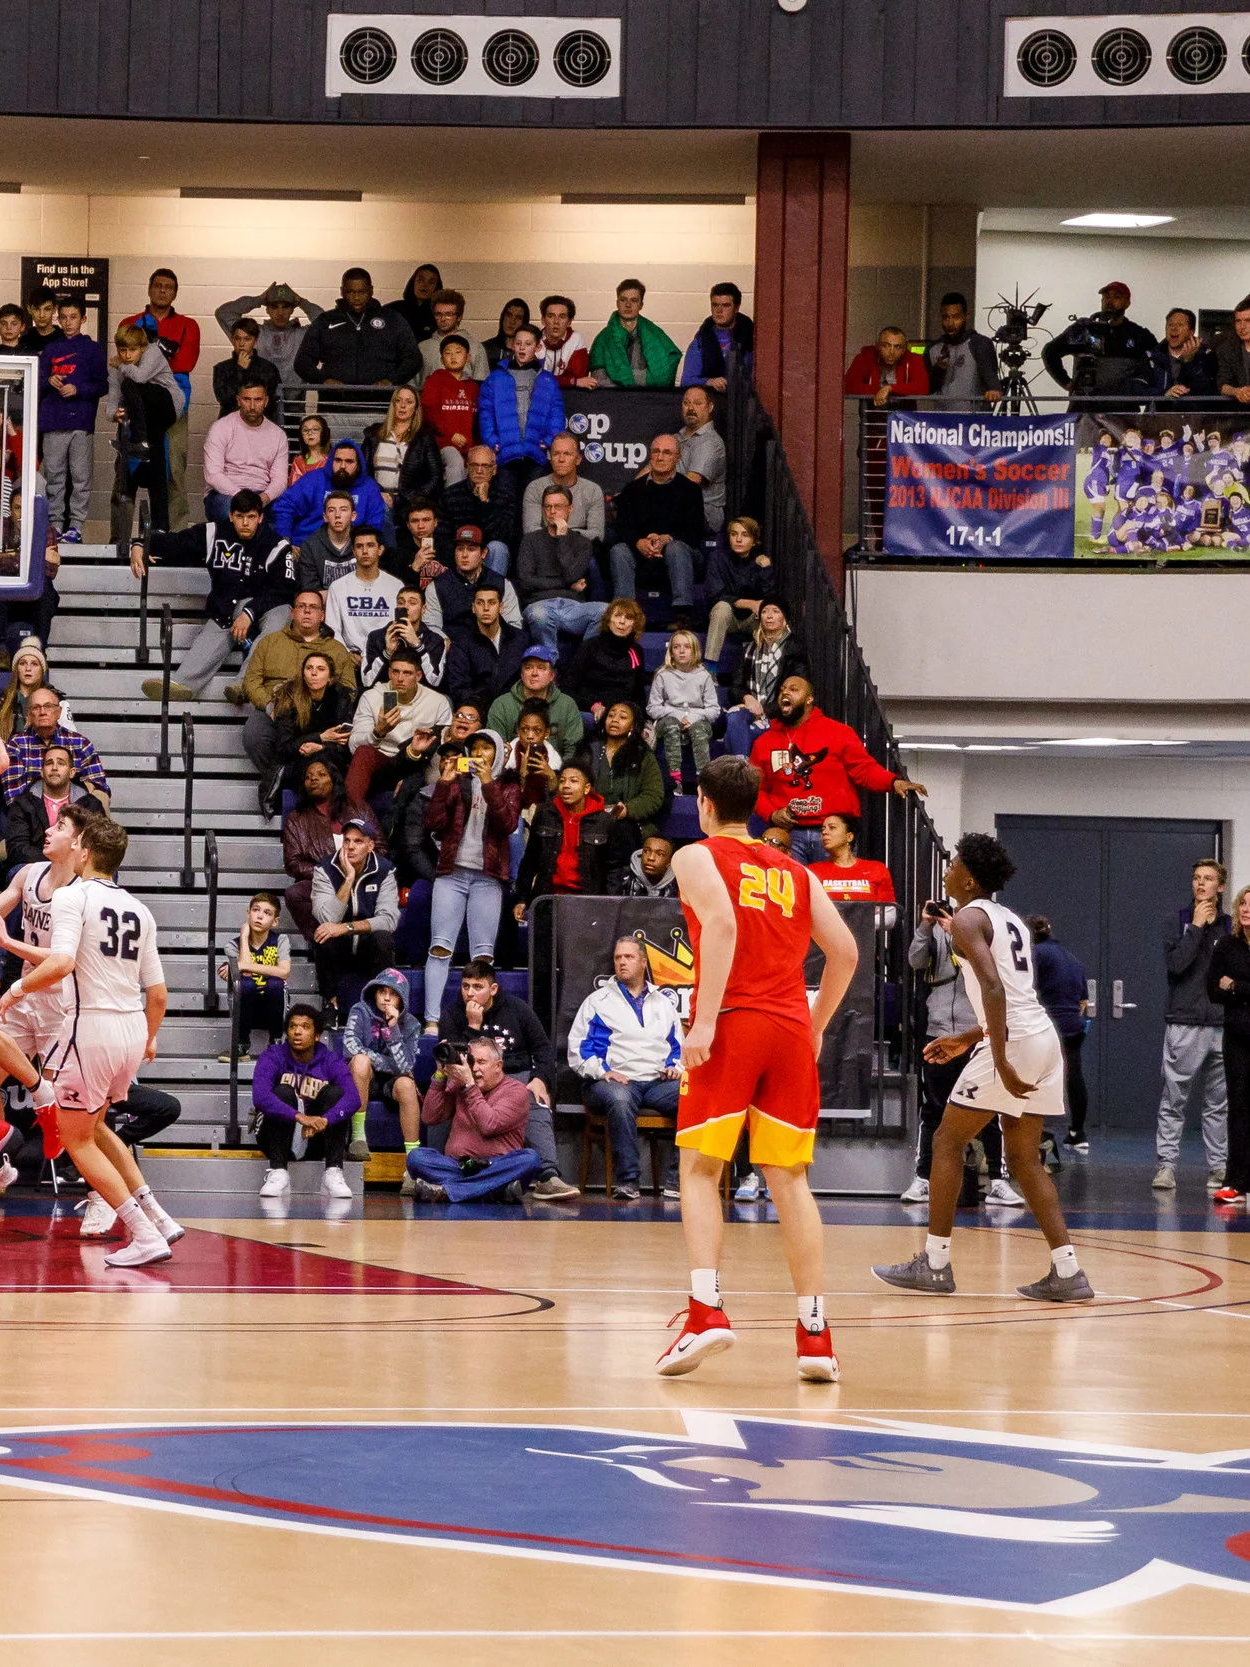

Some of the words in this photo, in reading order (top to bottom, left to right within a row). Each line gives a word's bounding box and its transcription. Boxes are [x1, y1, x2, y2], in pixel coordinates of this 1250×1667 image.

[36, 264, 56, 274] Find
[57, 266, 68, 274] us
[70, 265, 78, 274] in
[80, 265, 95, 274] the
[42, 277, 60, 288] App
[62, 277, 88, 287] Store!
[890, 420, 963, 446] National
[968, 422, 1075, 451] Champions!!
[890, 455, 987, 481] Women's
[993, 457, 1071, 481] Soccer
[888, 485, 926, 508] 2013
[930, 486, 983, 509] NJCAA
[988, 487, 1048, 510] Division
[946, 526, 1001, 546] 17-1-1
[346, 596, 390, 610] CBA
[738, 862, 796, 918] 24
[822, 879, 870, 887] BASKETBALL
[22, 900, 52, 932] RANNE
[100, 907, 141, 961] 32
[1006, 921, 1029, 972] 2
